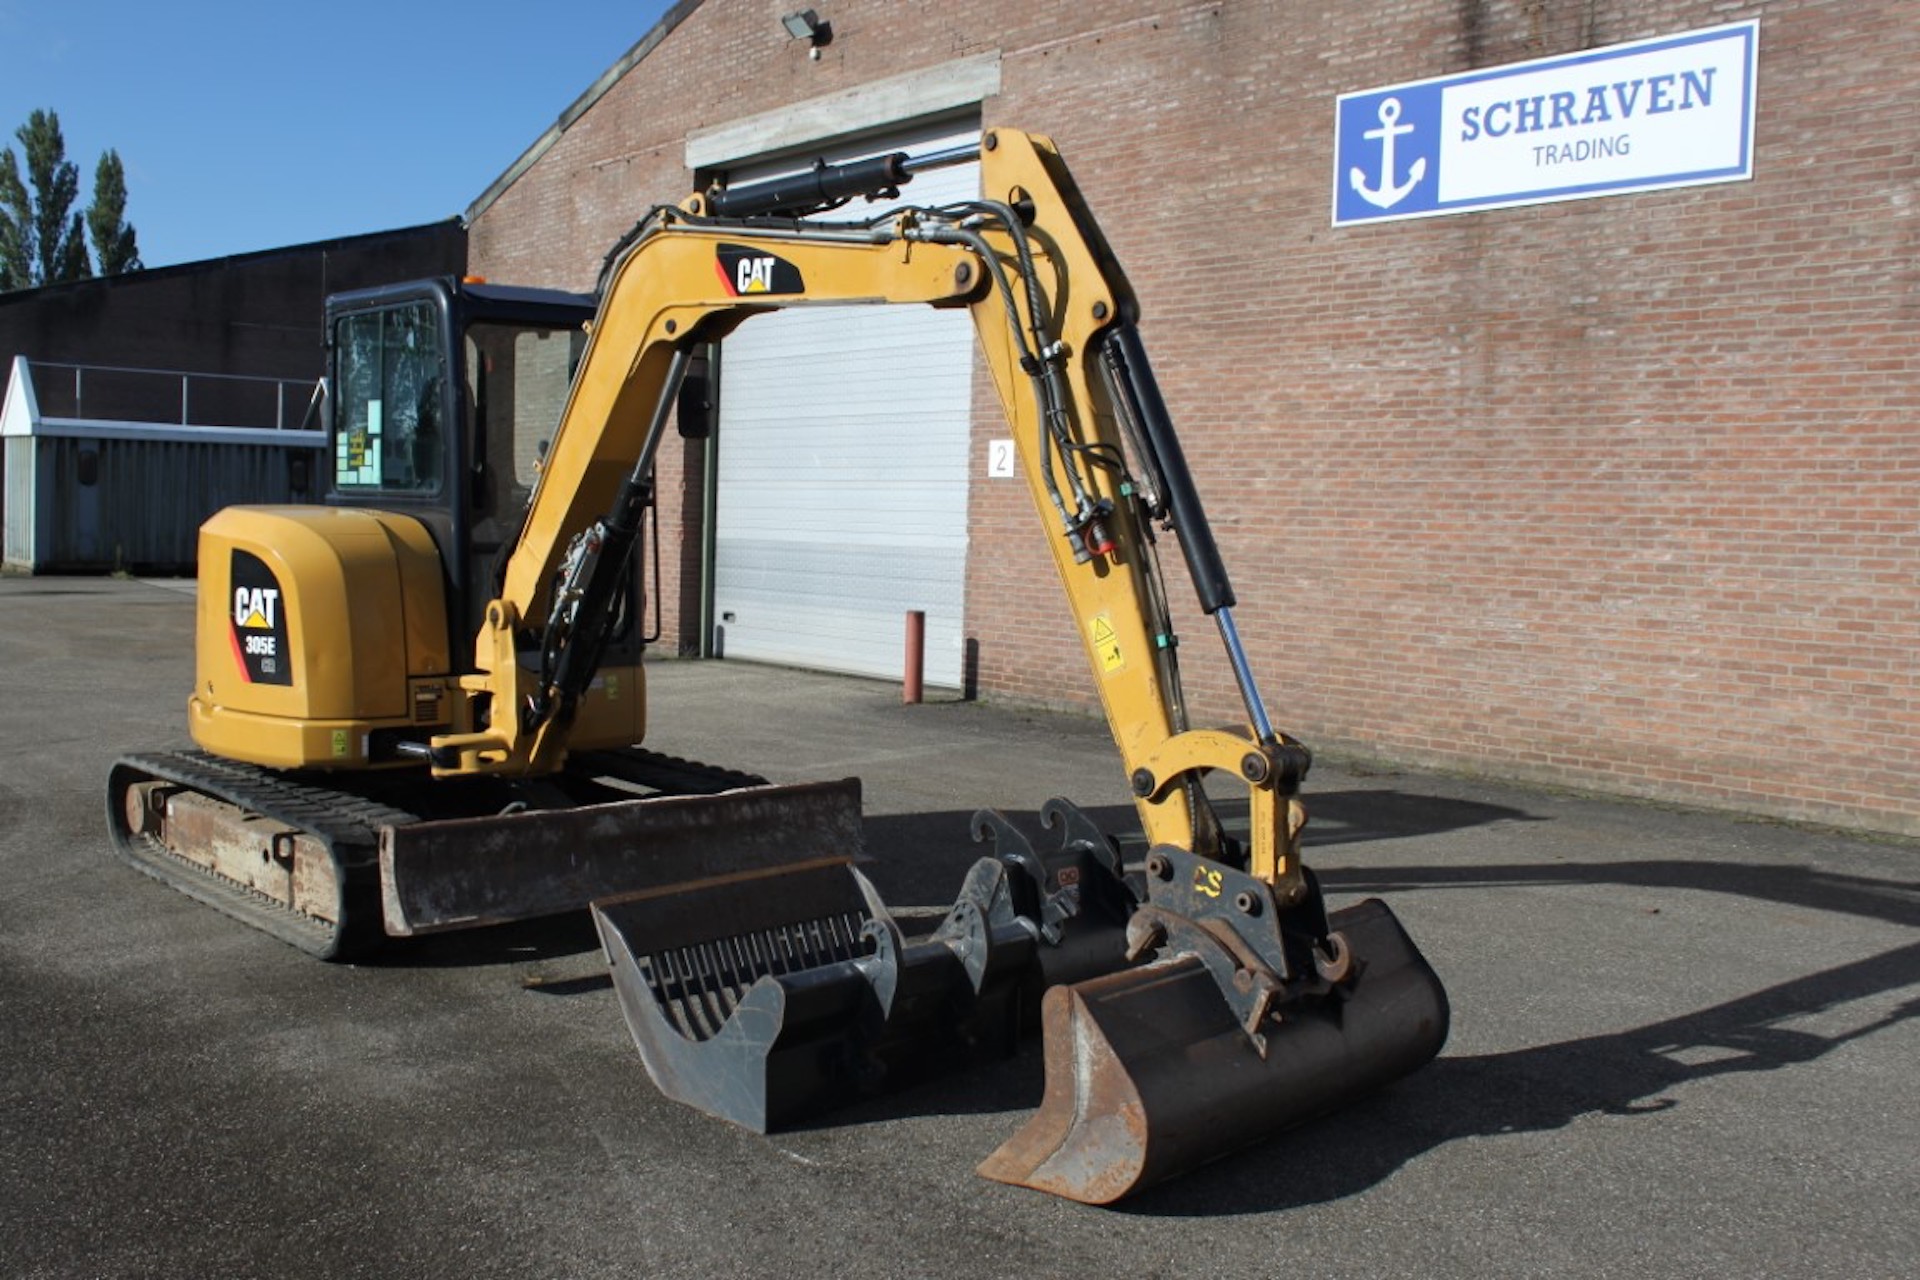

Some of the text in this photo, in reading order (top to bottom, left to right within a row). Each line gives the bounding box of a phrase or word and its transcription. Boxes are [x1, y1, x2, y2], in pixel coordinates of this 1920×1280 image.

[1462, 68, 1717, 142] SCHRAVEN
[1534, 134, 1631, 167] TRADING
[737, 257, 776, 293] CAT
[996, 445, 1007, 471] 2
[236, 586, 278, 629] CAT
[246, 635, 276, 655] 305E
